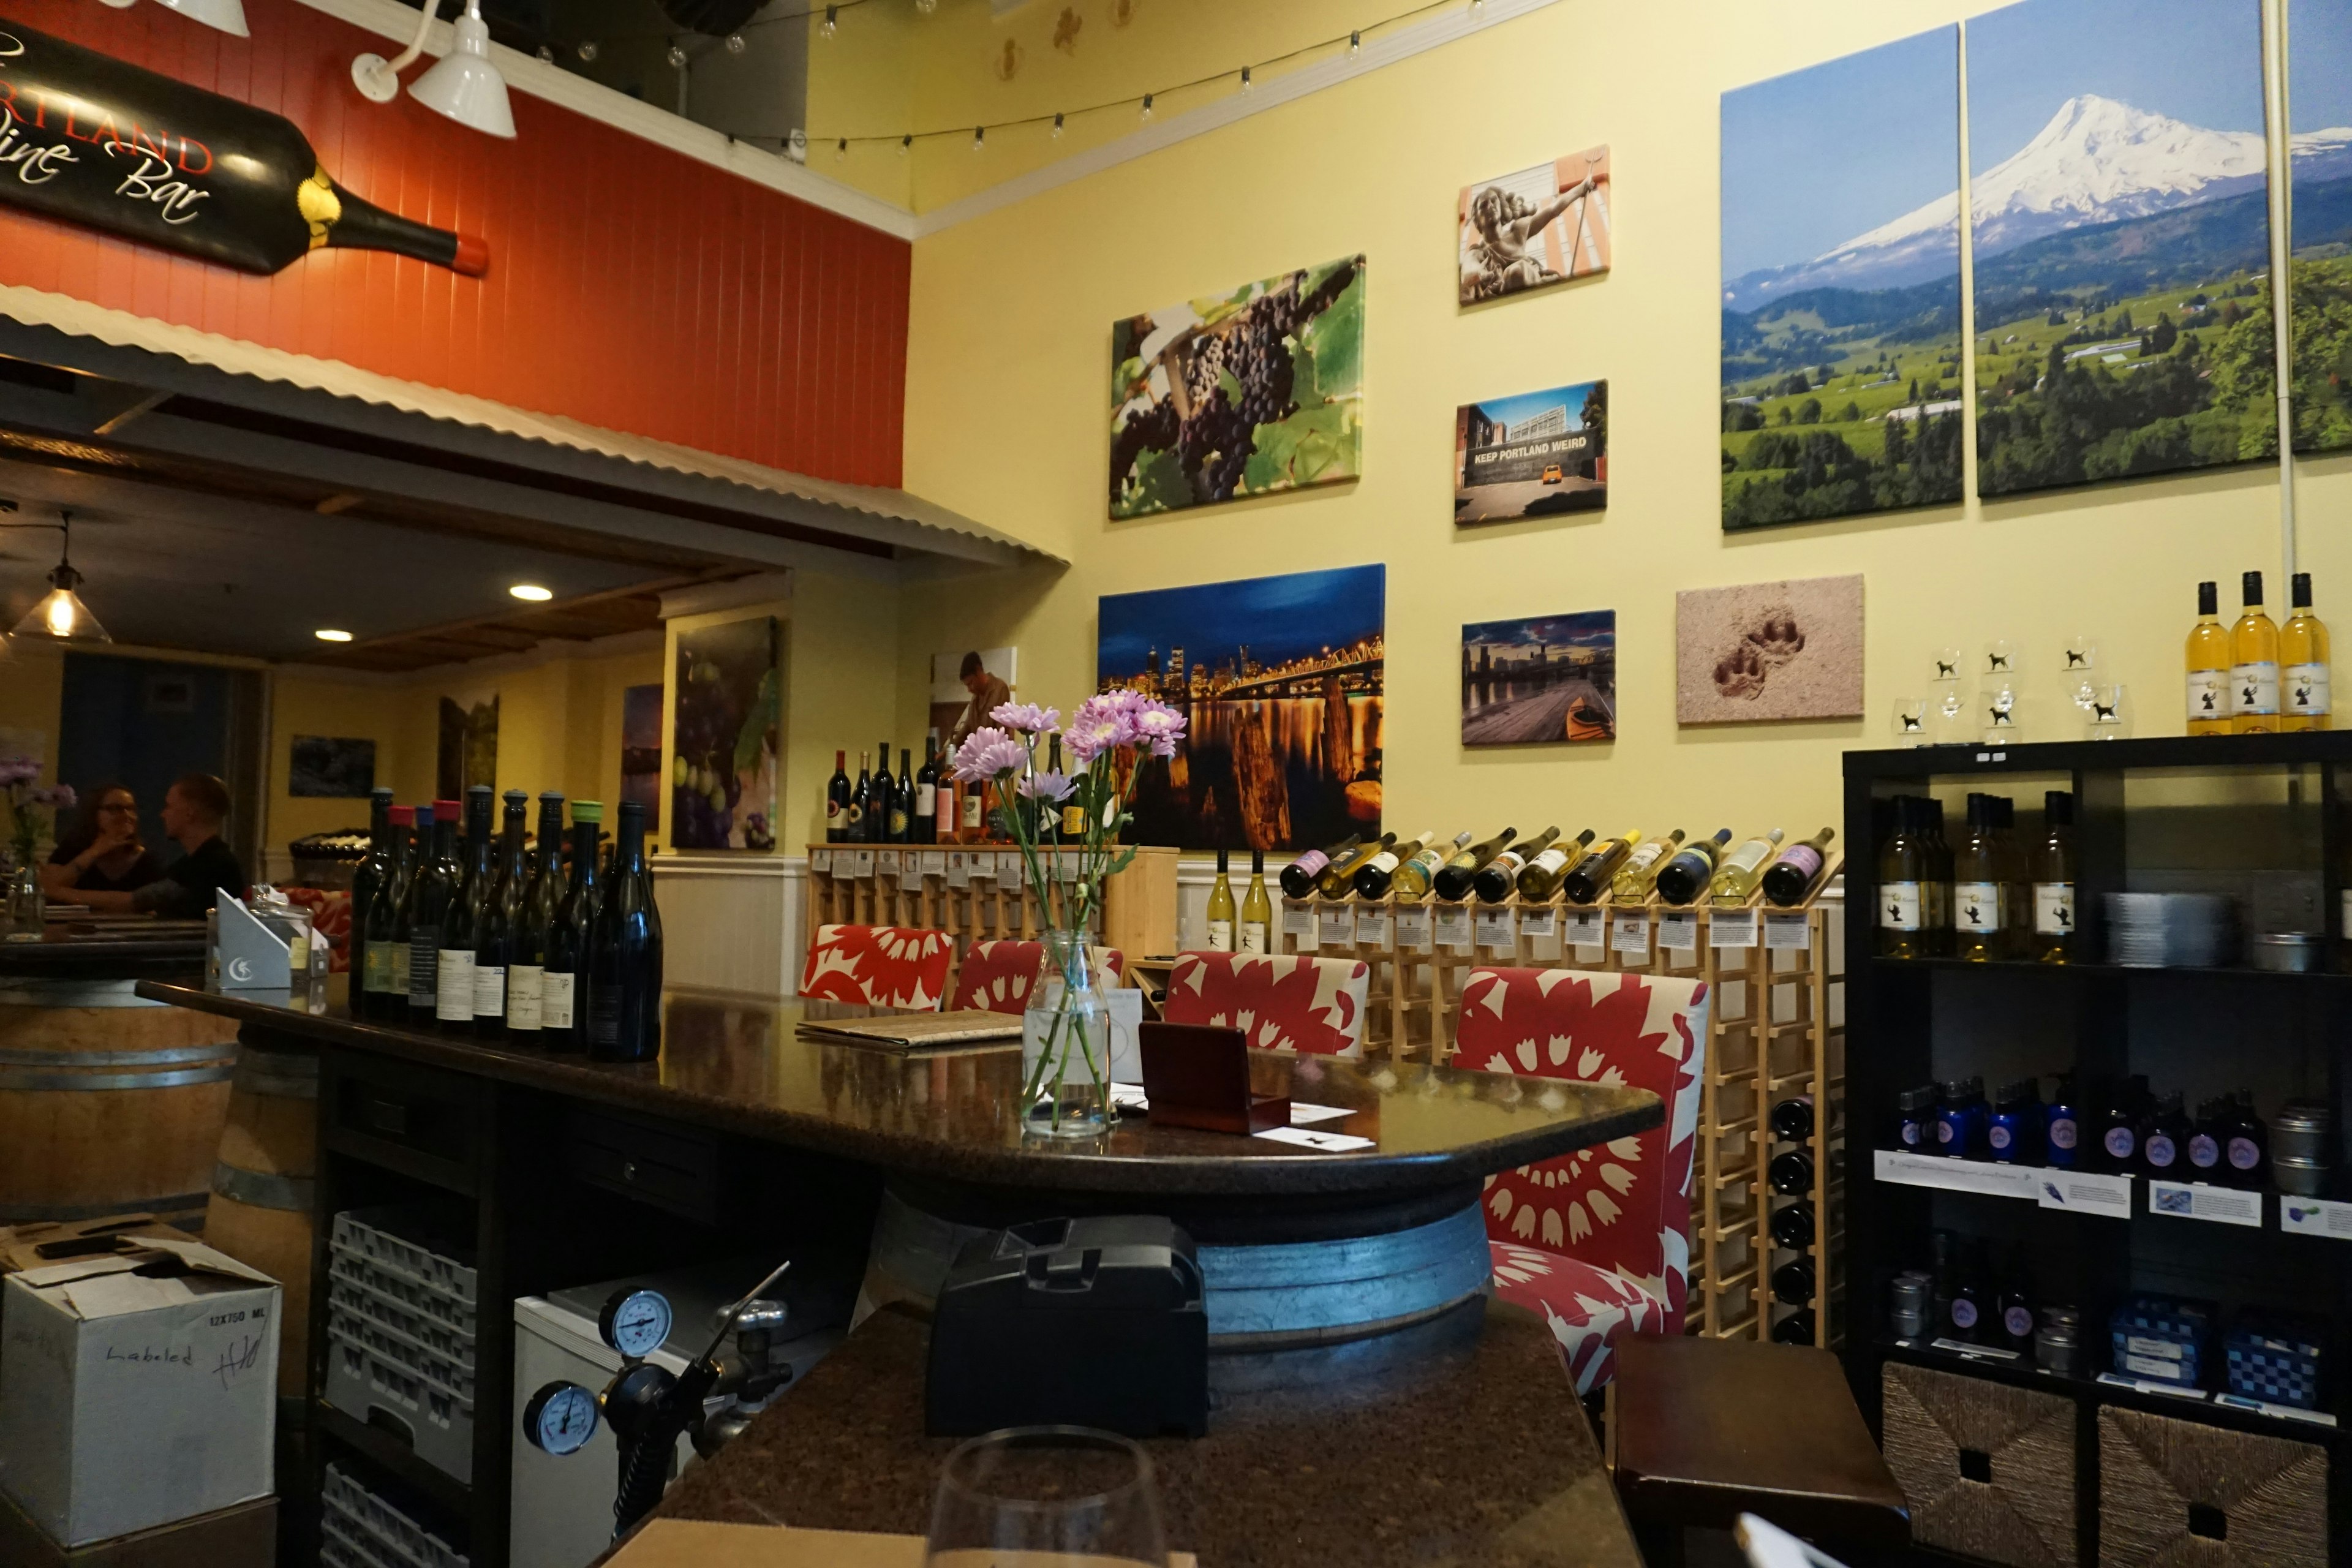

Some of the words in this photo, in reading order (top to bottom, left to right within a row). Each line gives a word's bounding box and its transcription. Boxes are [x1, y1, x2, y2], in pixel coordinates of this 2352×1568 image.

[0, 107, 80, 184] ine
[104, 141, 211, 225] Bar
[1475, 451, 1498, 464] KEEP
[1499, 443, 1549, 460] PORTLAND
[1552, 436, 1586, 451] WEIRD
[252, 1308, 265, 1319] ML
[107, 1346, 192, 1366] Labeled
